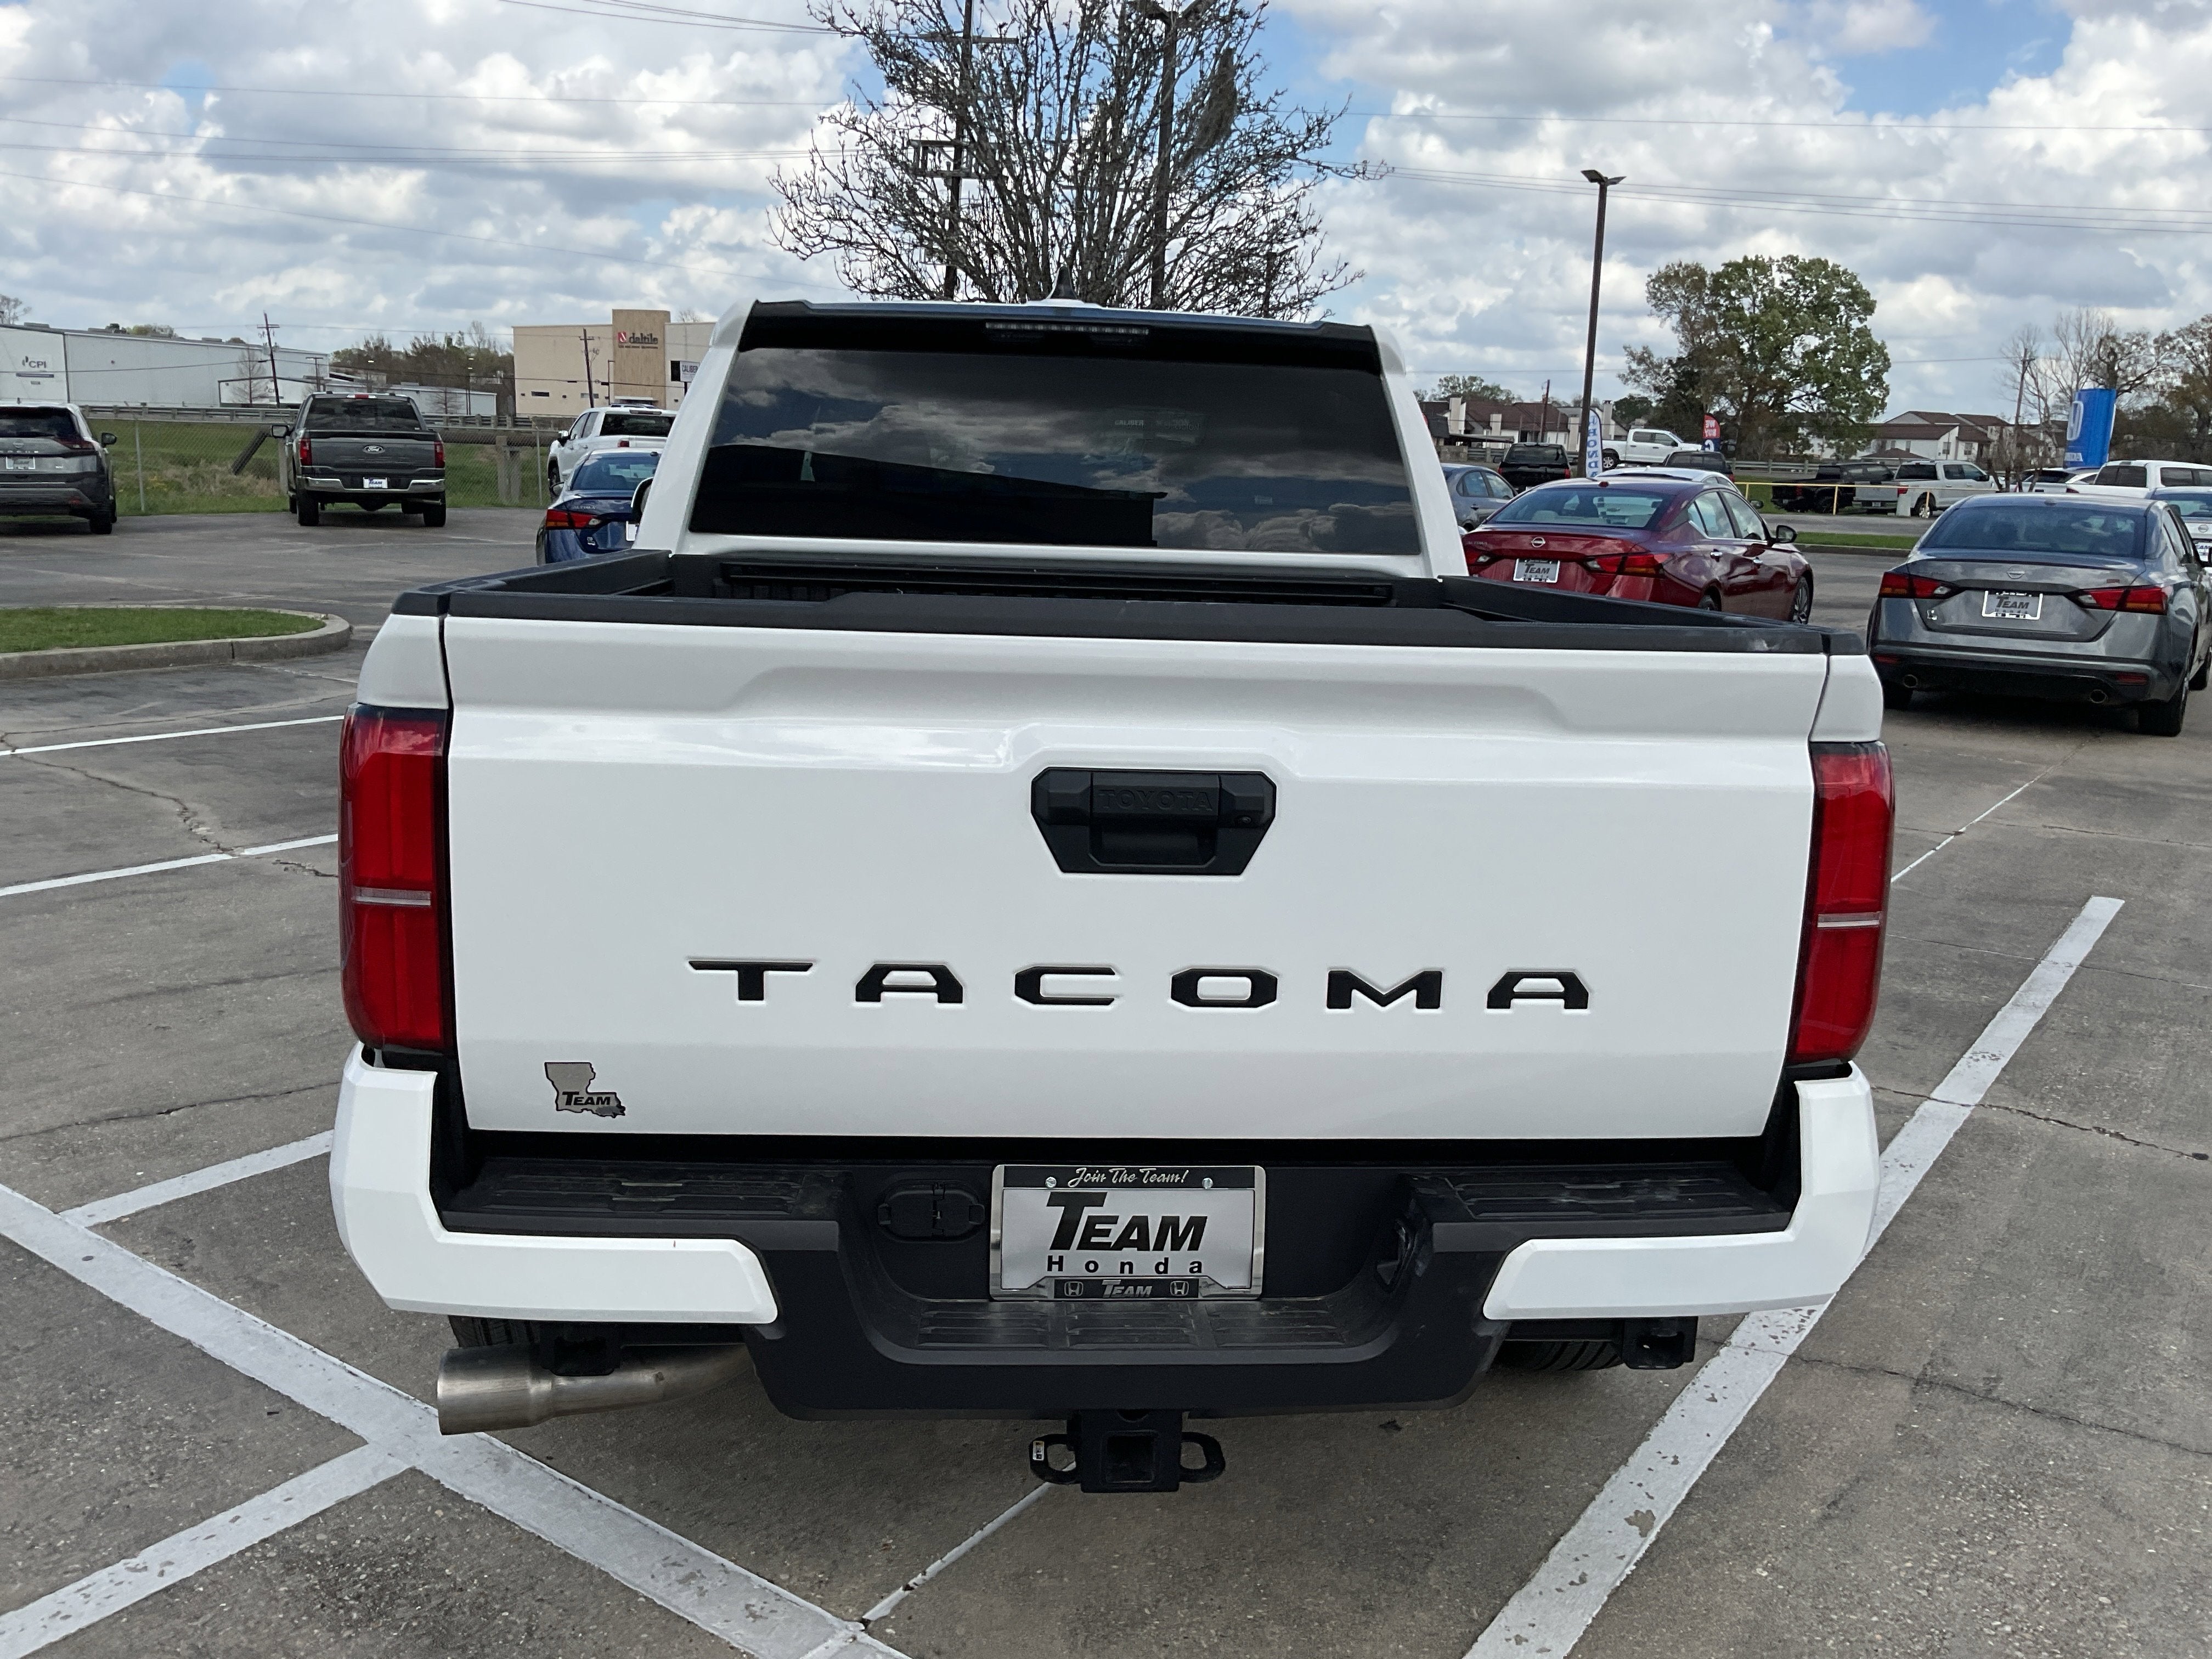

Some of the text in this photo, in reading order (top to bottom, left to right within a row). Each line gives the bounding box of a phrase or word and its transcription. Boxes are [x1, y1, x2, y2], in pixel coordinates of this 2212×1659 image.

[629, 332, 658, 345] daltile
[29, 360, 47, 369] CPI
[1524, 563, 1550, 574] TEAM
[1996, 596, 2030, 609] TEAM
[1098, 789, 1212, 811] TOYOTA
[686, 960, 1591, 1011] TACOMA
[562, 1091, 611, 1106] TEAM
[1067, 1167, 1189, 1188] Join The Team!
[1046, 1191, 1208, 1251] TEAM
[1047, 1255, 1203, 1274] Honda
[1101, 1279, 1152, 1299] TEAM
